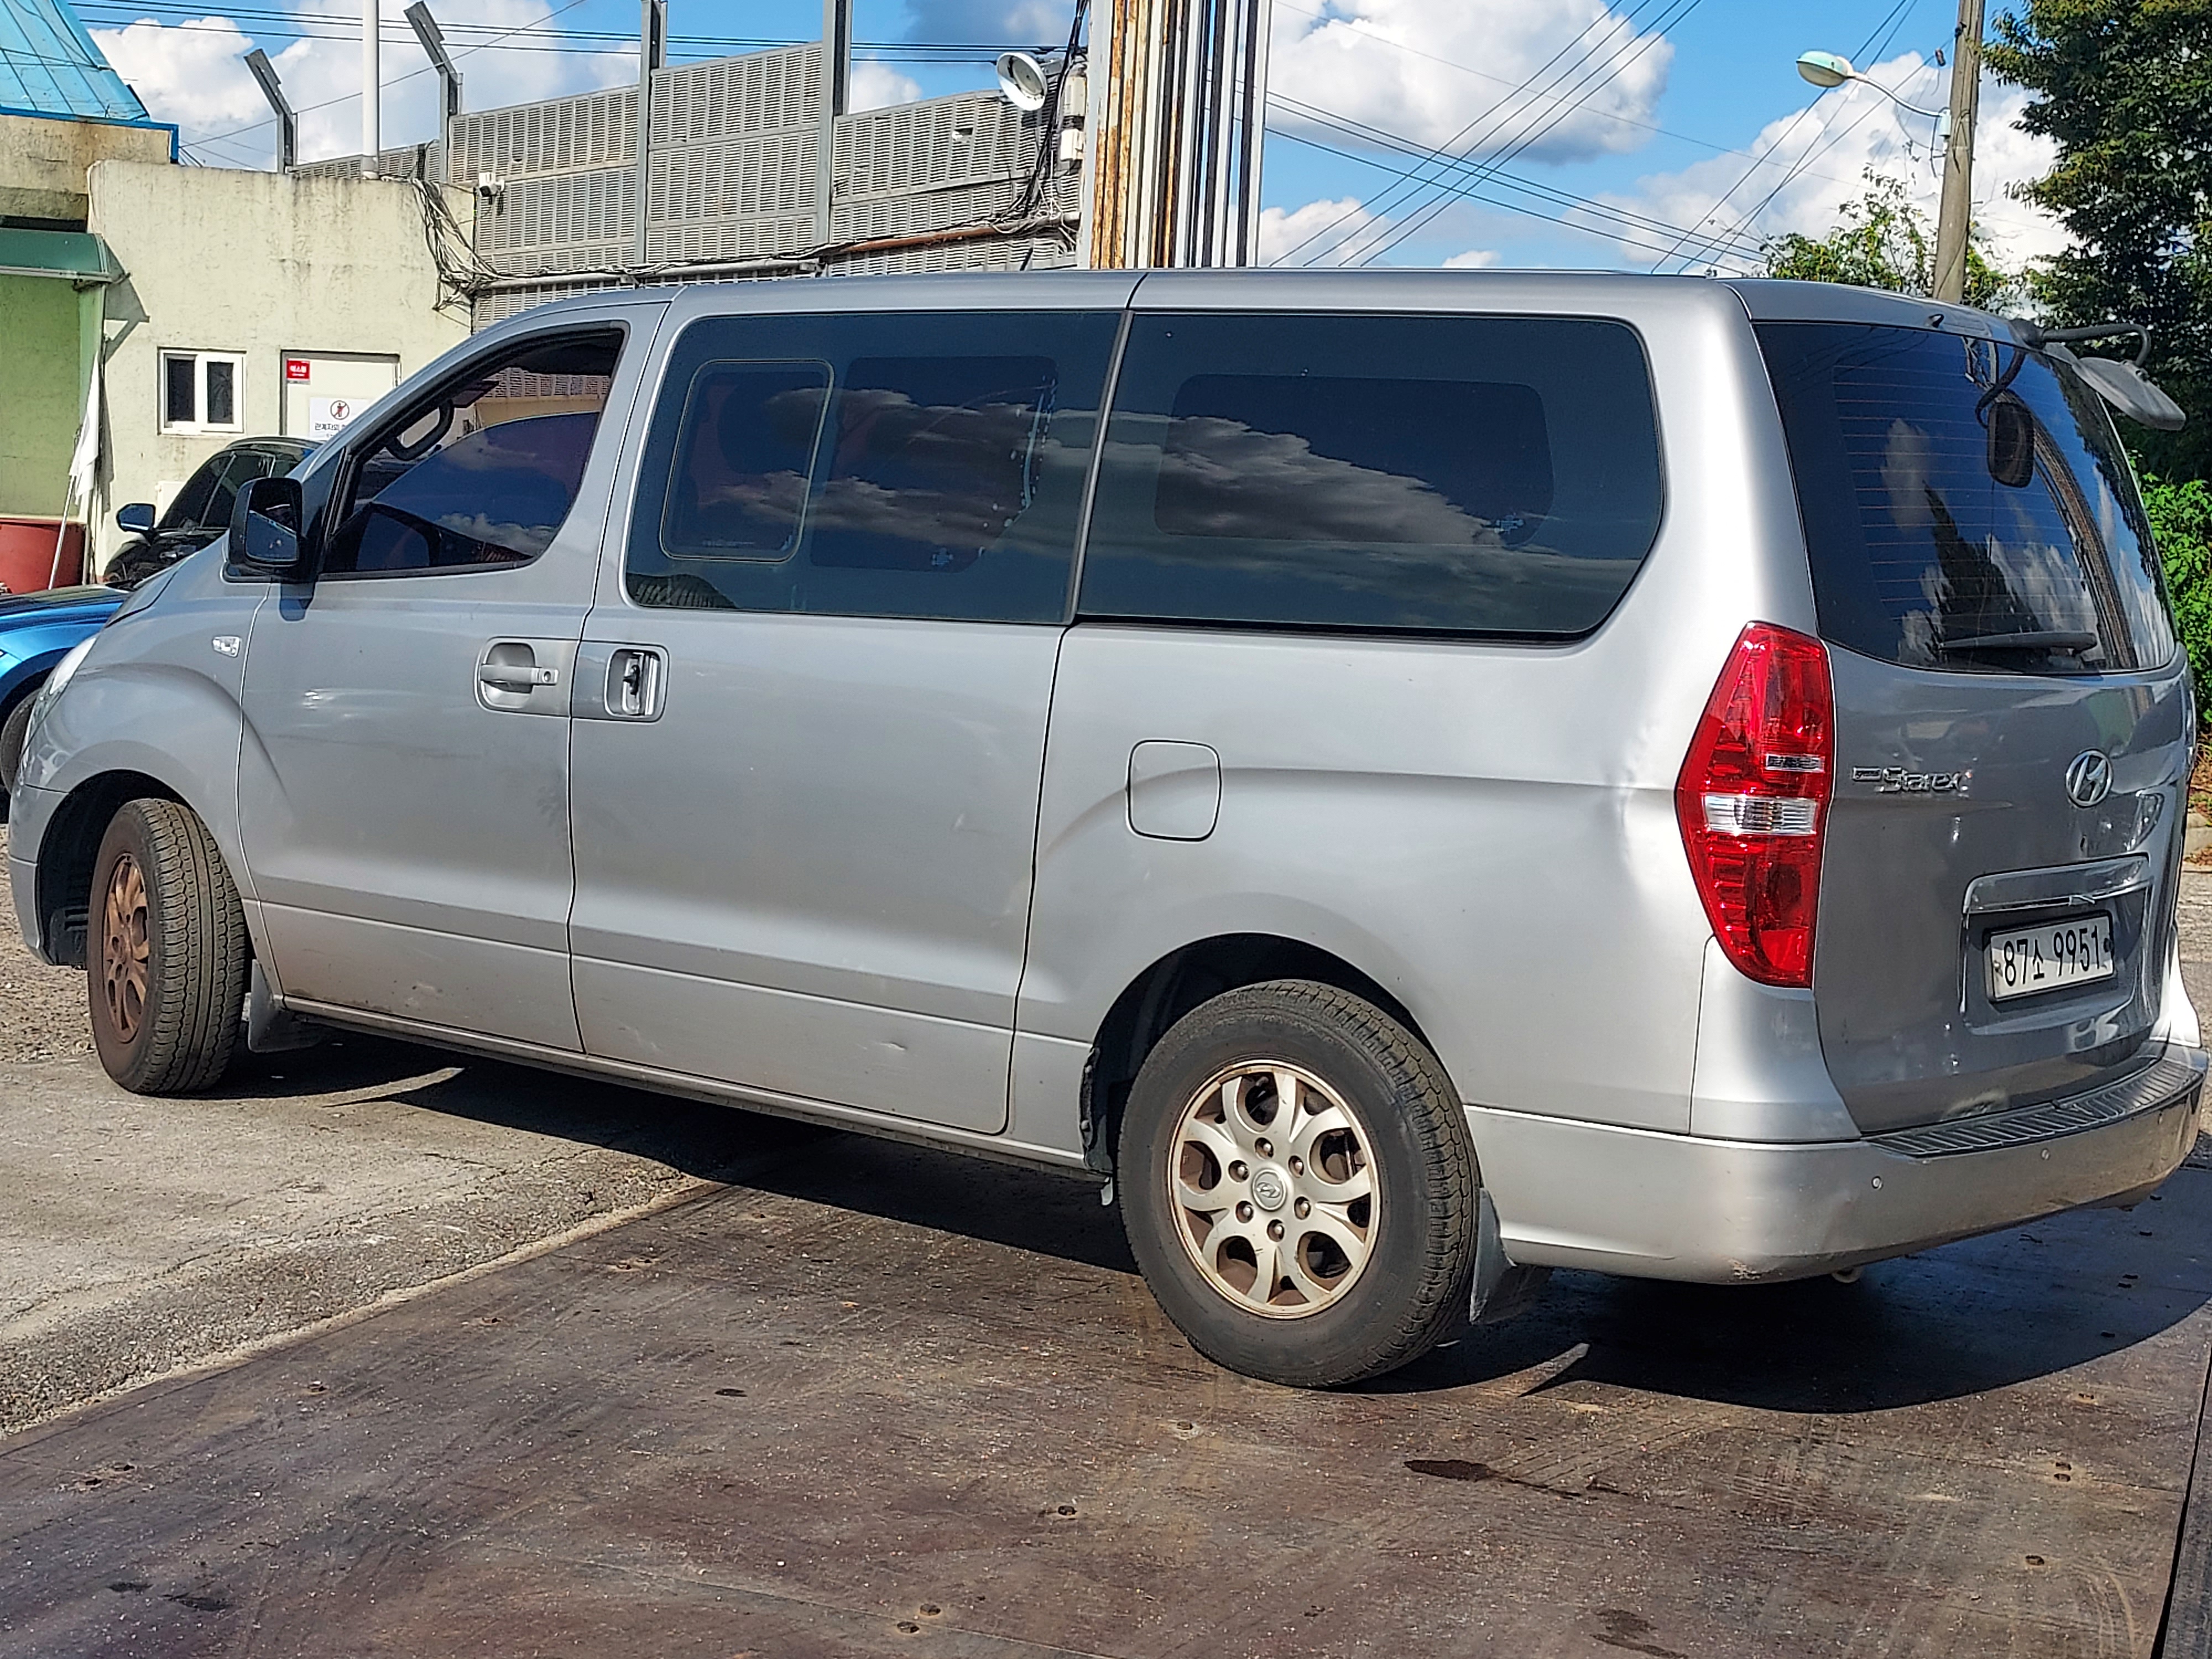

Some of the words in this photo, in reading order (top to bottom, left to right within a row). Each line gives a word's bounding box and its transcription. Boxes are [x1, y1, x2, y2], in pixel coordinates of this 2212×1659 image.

[1875, 767, 1970, 793] Starex
[2004, 938, 2045, 987] 87소
[2053, 925, 2100, 977] 9951
